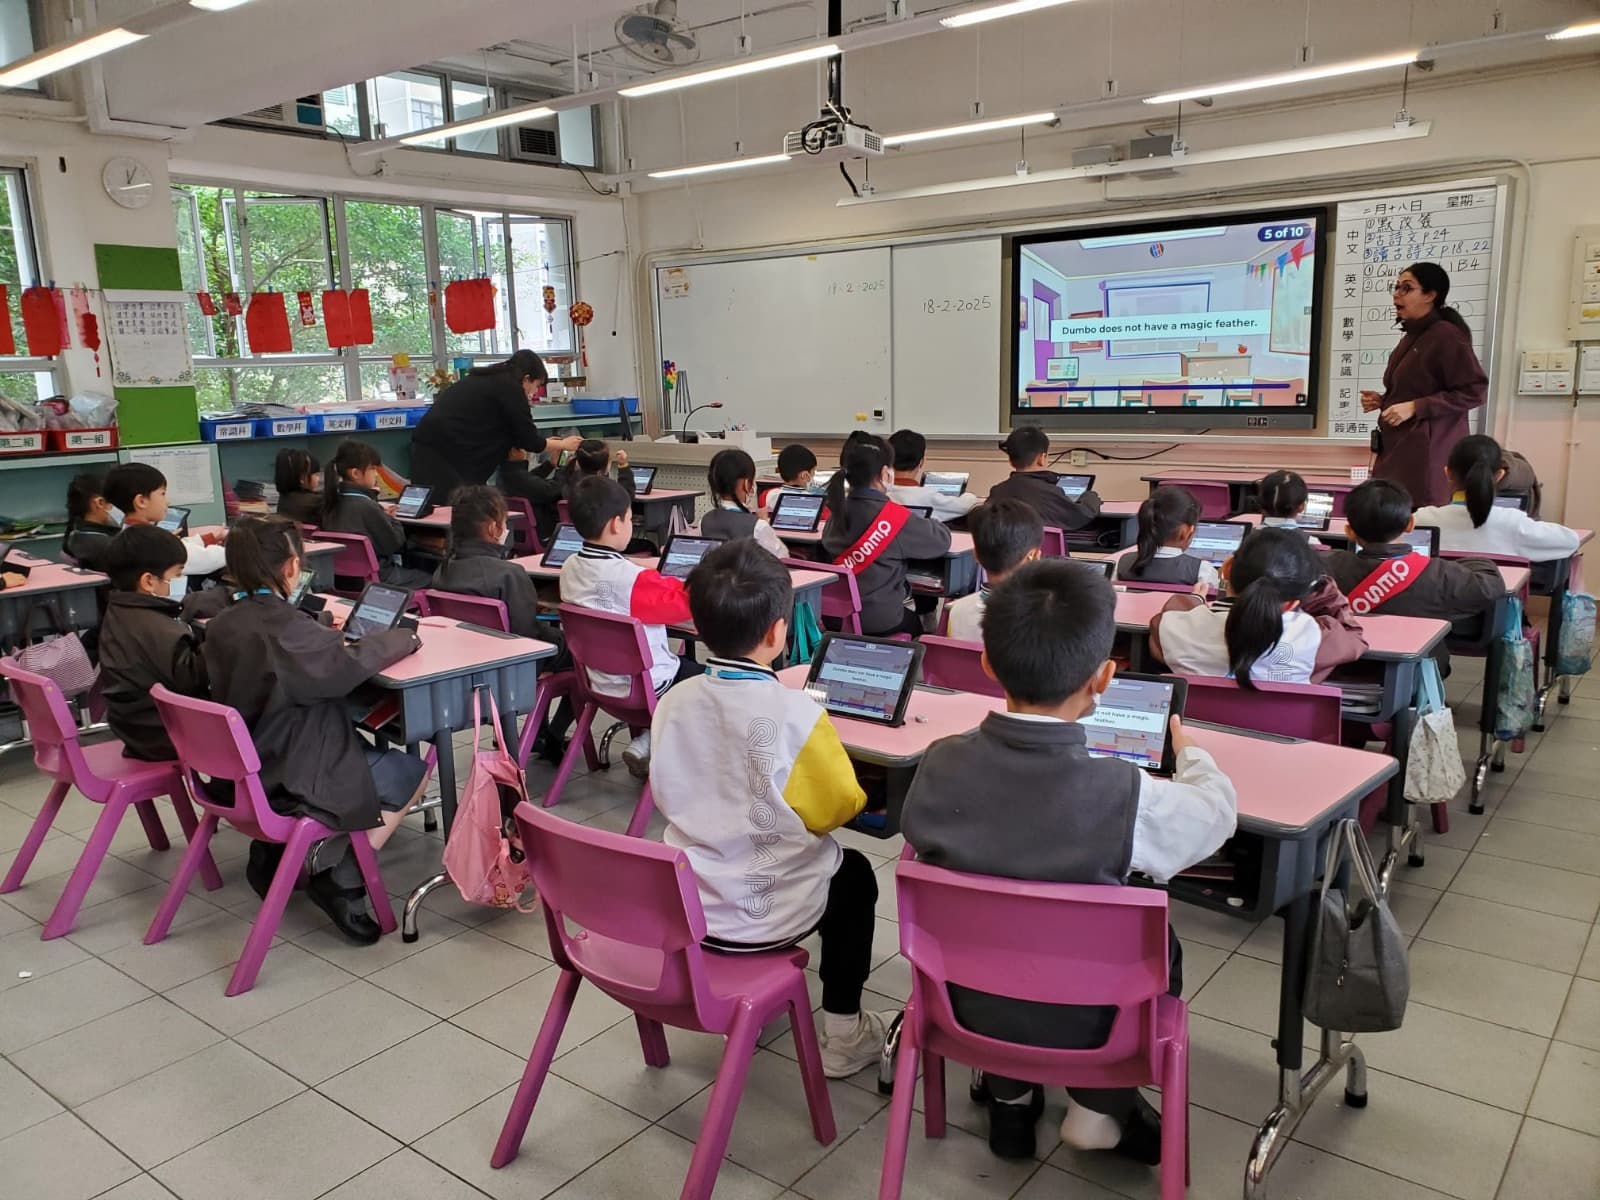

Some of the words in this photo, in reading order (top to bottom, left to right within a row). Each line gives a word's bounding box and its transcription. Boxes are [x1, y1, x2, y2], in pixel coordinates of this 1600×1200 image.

[1264, 229, 1273, 239] 5
[1275, 227, 1288, 239] of
[1290, 226, 1304, 238] 10
[1346, 229, 1359, 255] 中文
[1344, 274, 1357, 298] 英文
[923, 295, 992, 314] 18-2-2025
[1062, 325, 1097, 335] Dumbo
[1099, 324, 1122, 333] does
[1125, 323, 1141, 332] not
[1144, 322, 1168, 331] have
[1180, 319, 1212, 331] magic
[1215, 318, 1258, 328] feather.
[1343, 317, 1354, 341] 數學
[1340, 353, 1353, 376] 常識
